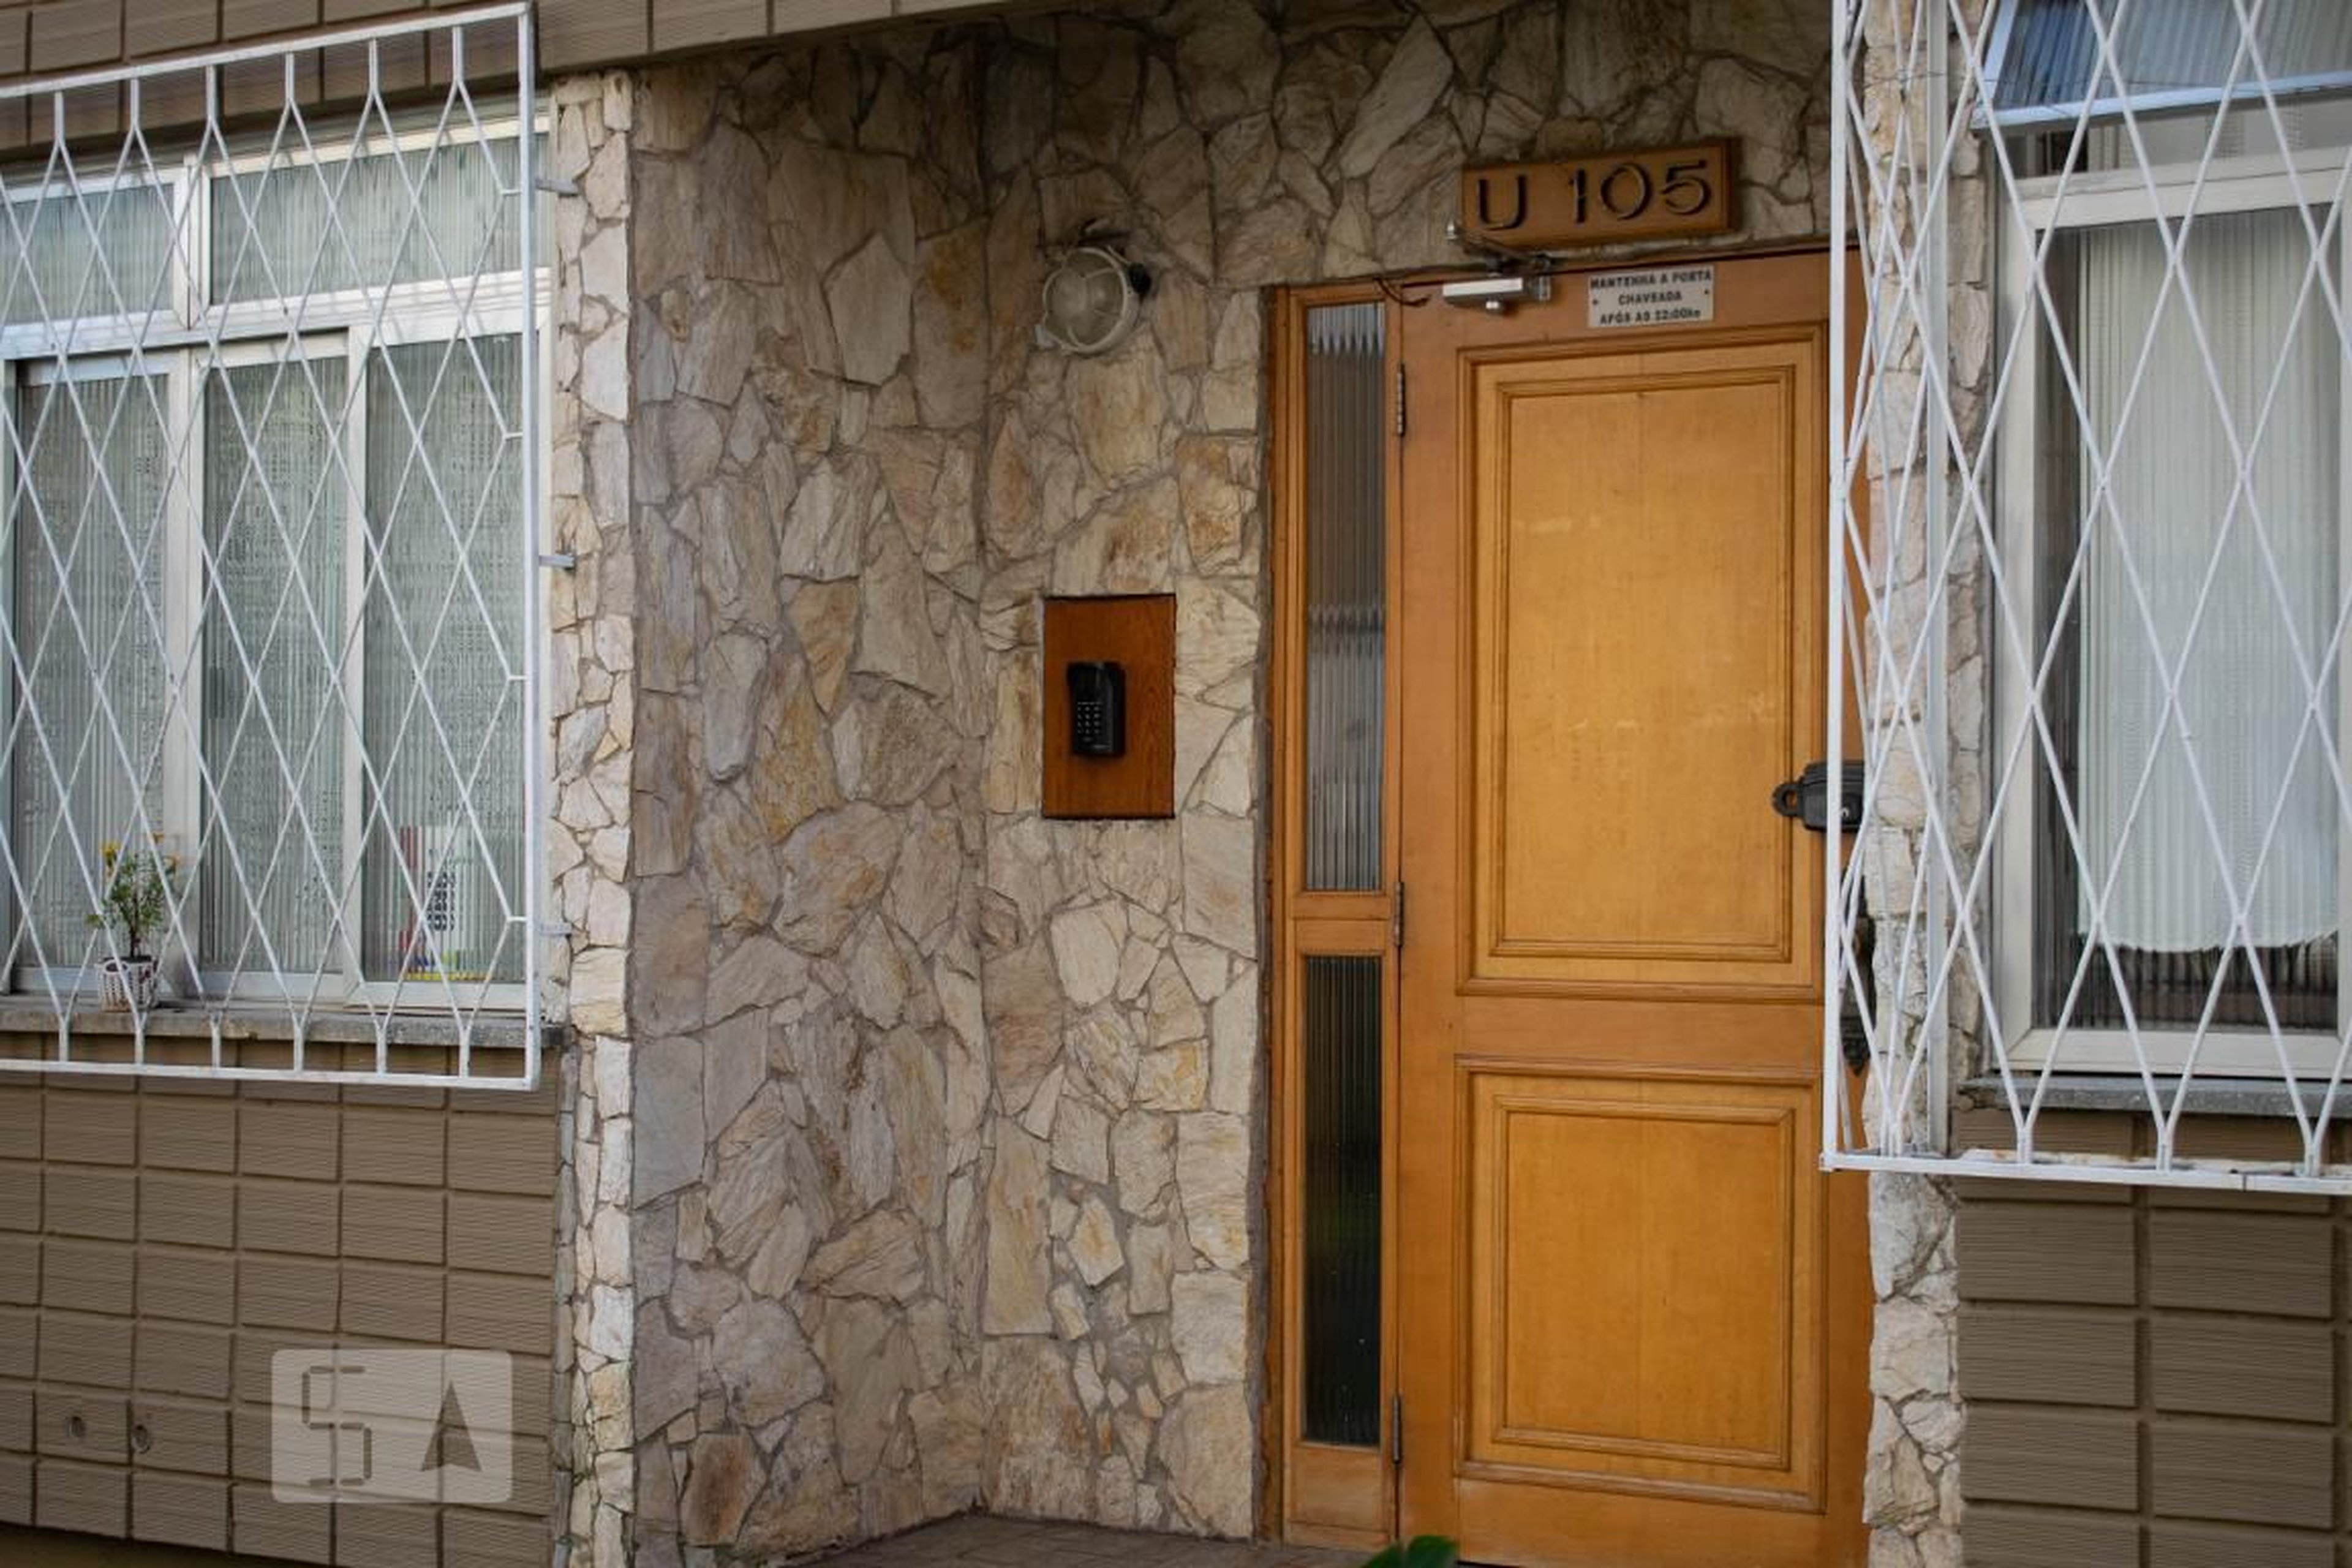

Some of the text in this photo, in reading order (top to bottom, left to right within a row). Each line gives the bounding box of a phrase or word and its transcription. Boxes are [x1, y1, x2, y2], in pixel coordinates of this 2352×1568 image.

[1477, 159, 1713, 230] U 105
[1590, 270, 1711, 288] MANTENHA A PORTA
[1618, 290, 1682, 305] CHAVEADA
